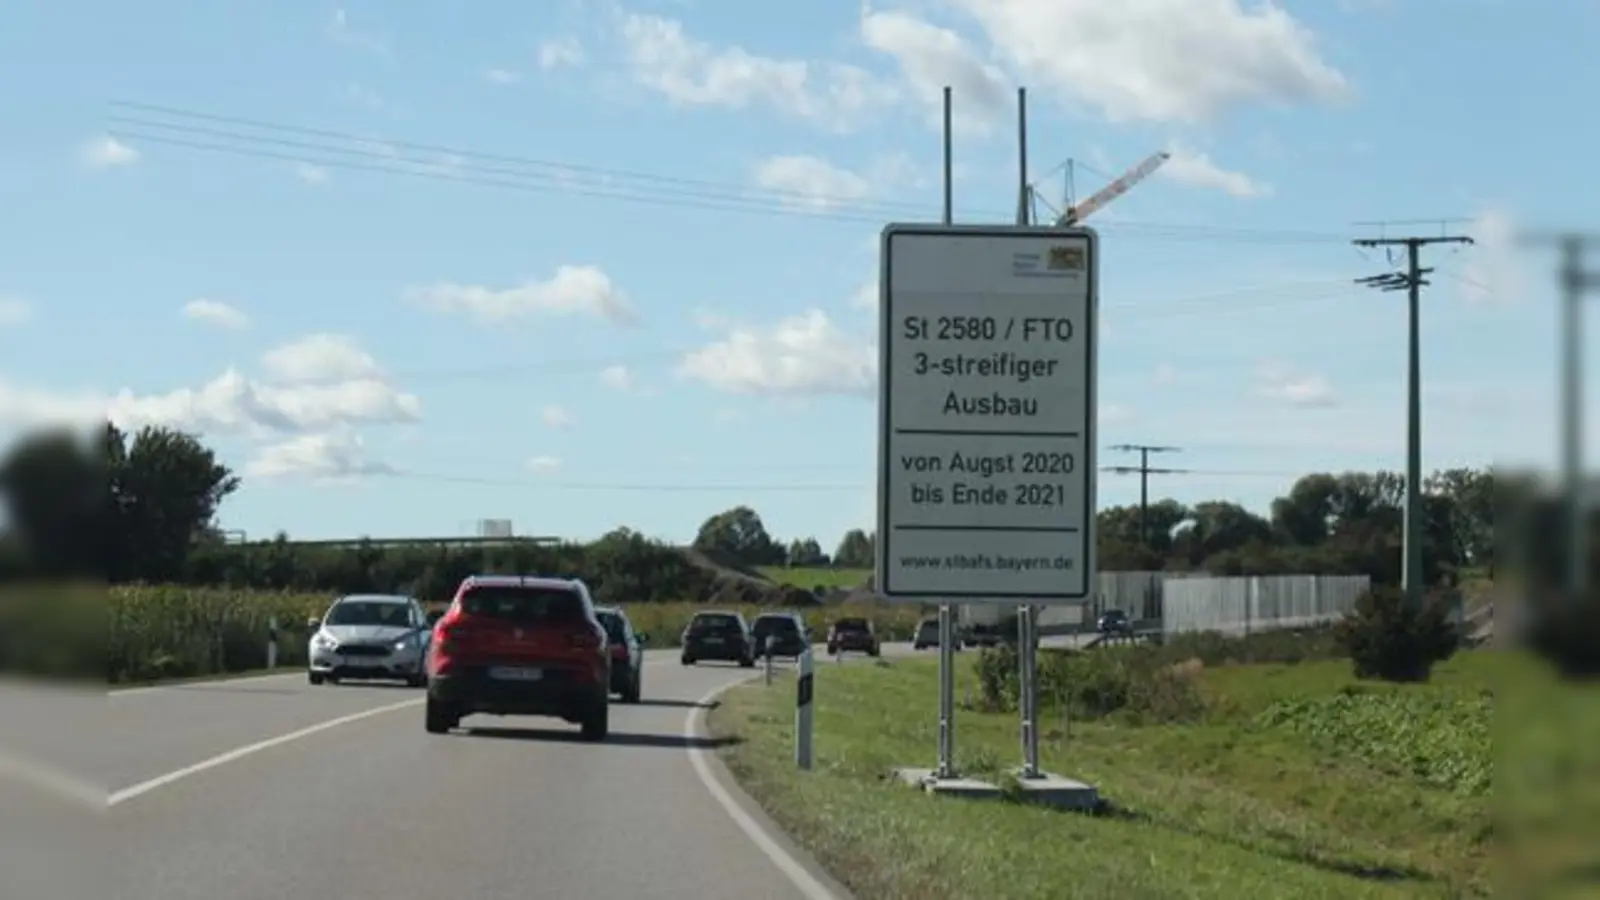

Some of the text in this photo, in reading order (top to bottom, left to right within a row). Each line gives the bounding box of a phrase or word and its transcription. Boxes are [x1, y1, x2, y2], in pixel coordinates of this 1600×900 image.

[904, 315, 1074, 342] St 2580 / FTO
[914, 351, 1059, 383] 3-streifiger
[942, 390, 1038, 417] Ausbau
[901, 451, 1075, 479] von Augst 2020
[911, 482, 1065, 506] bis Ende 2021
